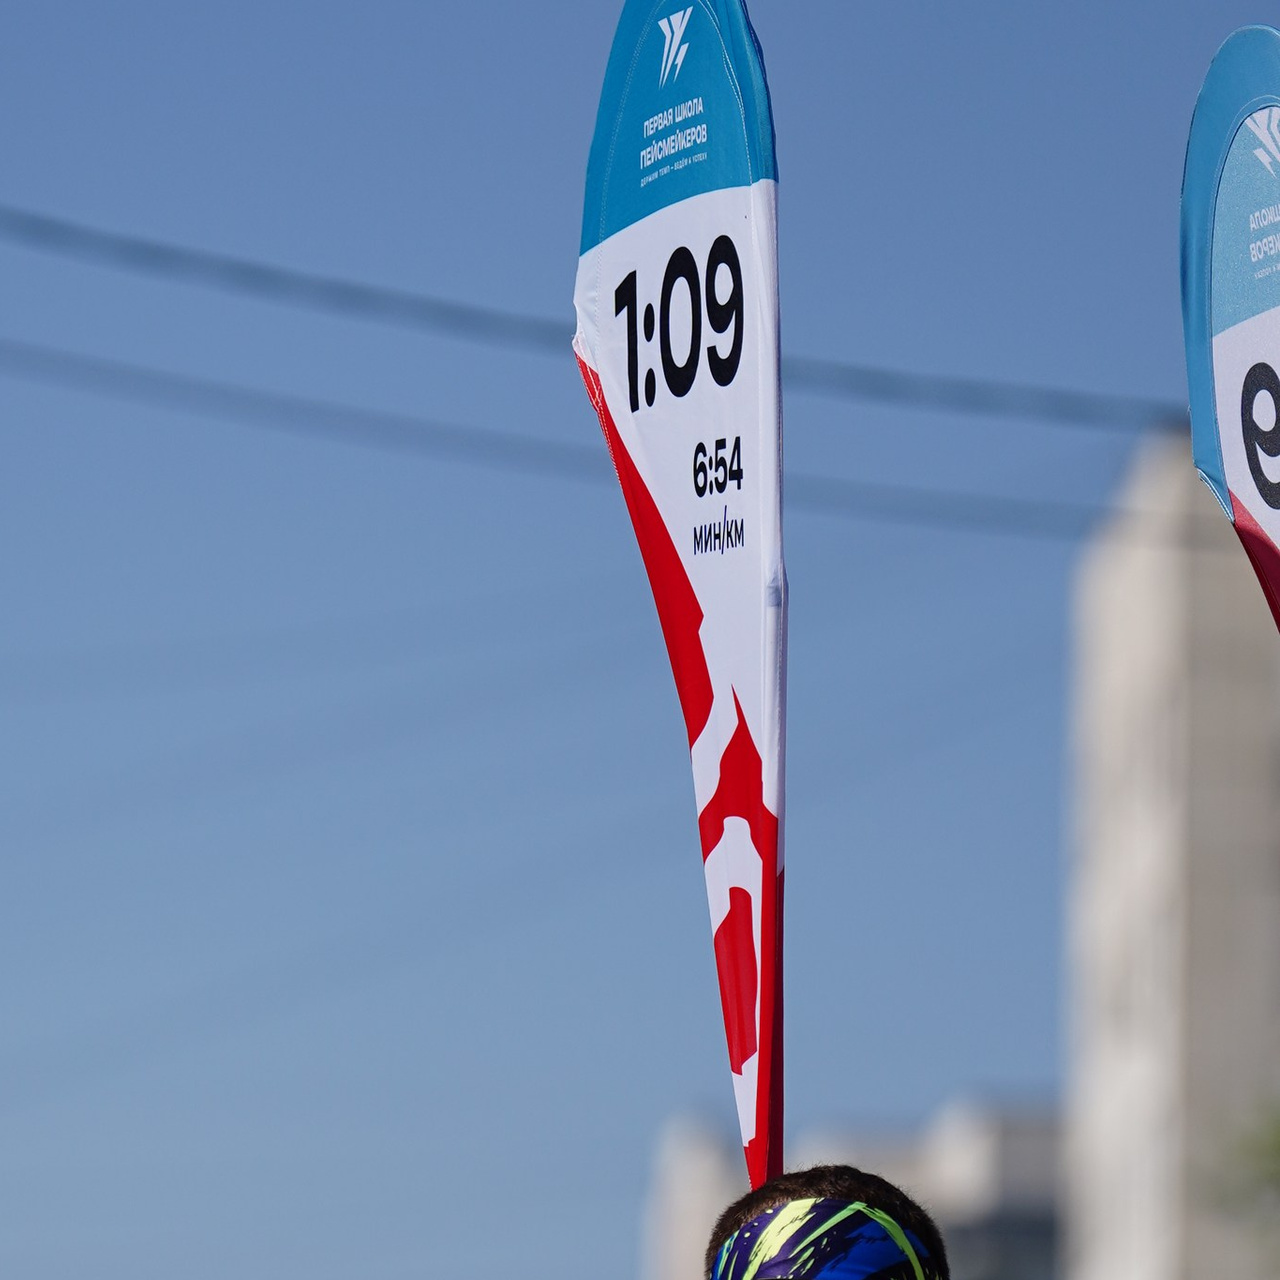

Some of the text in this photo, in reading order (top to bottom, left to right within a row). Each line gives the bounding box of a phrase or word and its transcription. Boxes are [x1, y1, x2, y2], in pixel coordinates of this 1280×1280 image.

[643, 97, 704, 138] ПЕРВАЯ ШКОЛА
[640, 124, 708, 170] ПЕЙСМЕЙКЕРОВ
[614, 234, 744, 413] 1:09
[693, 436, 744, 498] 6:54
